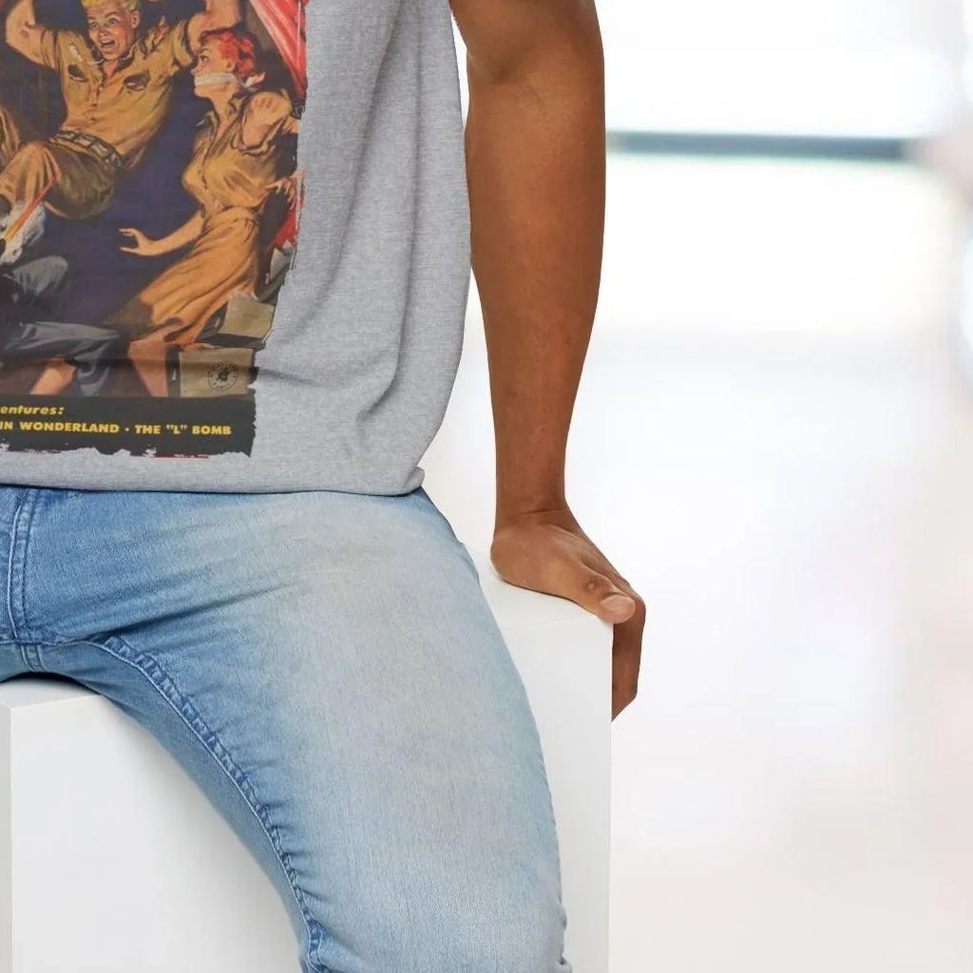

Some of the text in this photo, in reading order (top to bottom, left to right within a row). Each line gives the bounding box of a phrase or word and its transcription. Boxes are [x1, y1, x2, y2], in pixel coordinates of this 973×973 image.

[0, 421, 13, 430] IN
[19, 422, 119, 433] WONDERLAND
[134, 425, 161, 434] THE
[192, 425, 232, 435] BOMB
